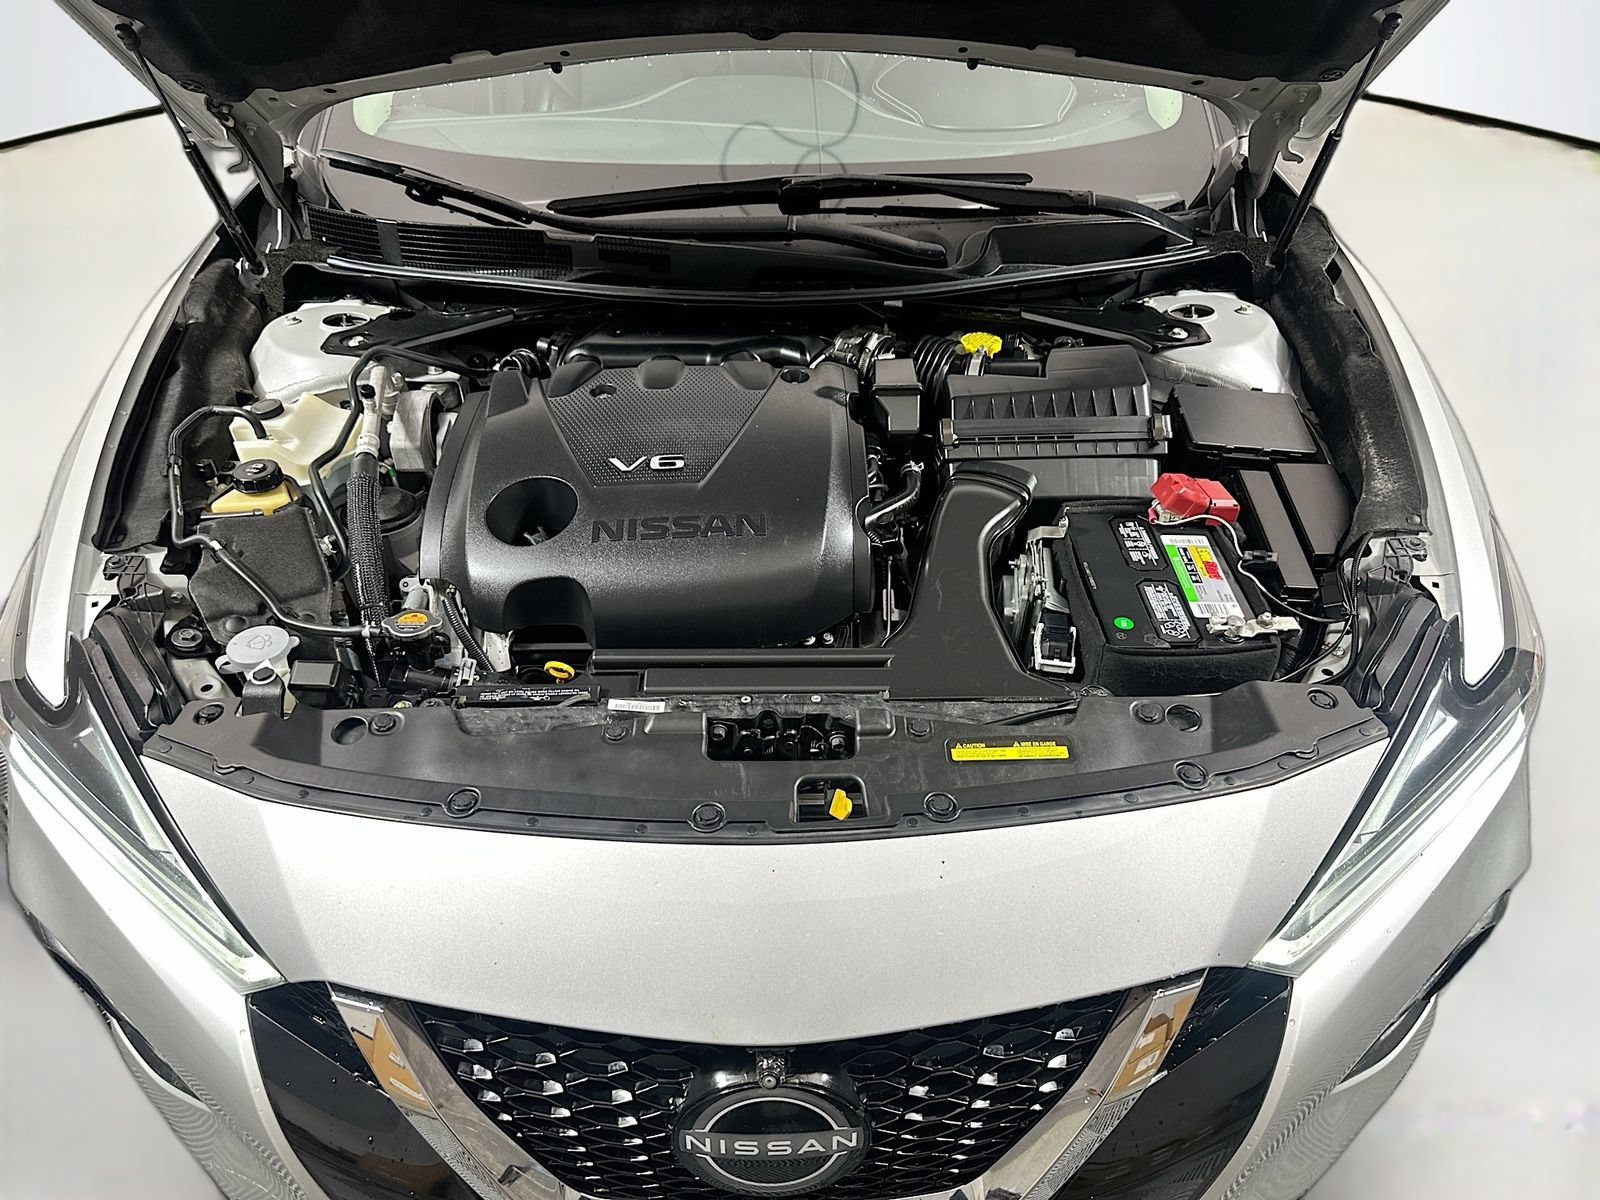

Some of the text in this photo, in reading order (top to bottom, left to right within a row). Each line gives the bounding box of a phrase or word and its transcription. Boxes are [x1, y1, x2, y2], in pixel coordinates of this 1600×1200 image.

[607, 454, 685, 473] V6
[591, 513, 767, 543] NISSAN
[685, 1132, 858, 1156] NISSAN
